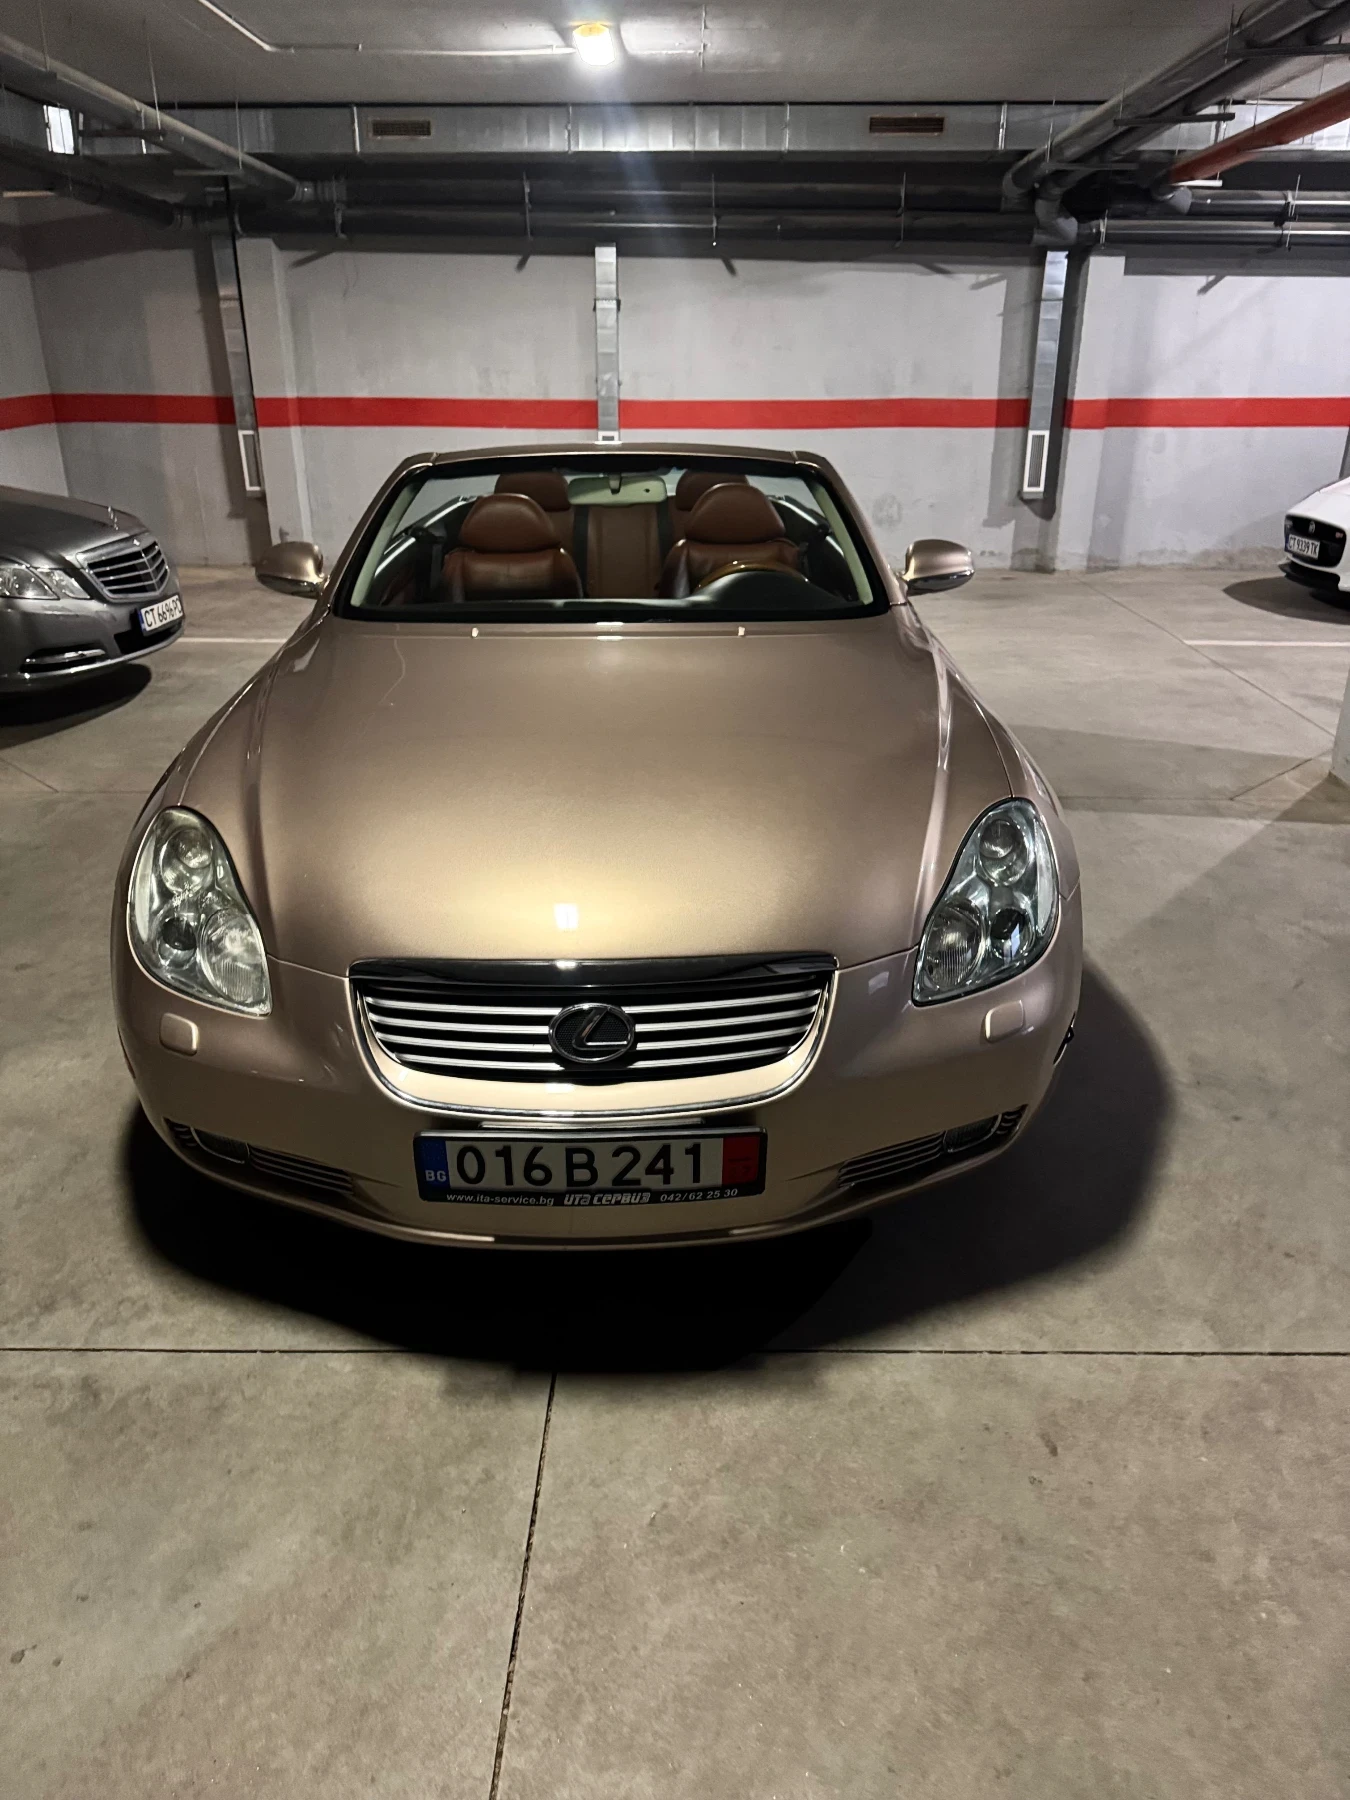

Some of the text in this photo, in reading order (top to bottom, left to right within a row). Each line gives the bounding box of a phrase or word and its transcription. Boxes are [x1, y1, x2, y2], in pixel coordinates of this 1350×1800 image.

[144, 607, 157, 627] CT
[424, 1169, 447, 1182] BG
[446, 1193, 555, 1206] www.ita-service.bg
[660, 1188, 738, 1202] 042/62 25 30
